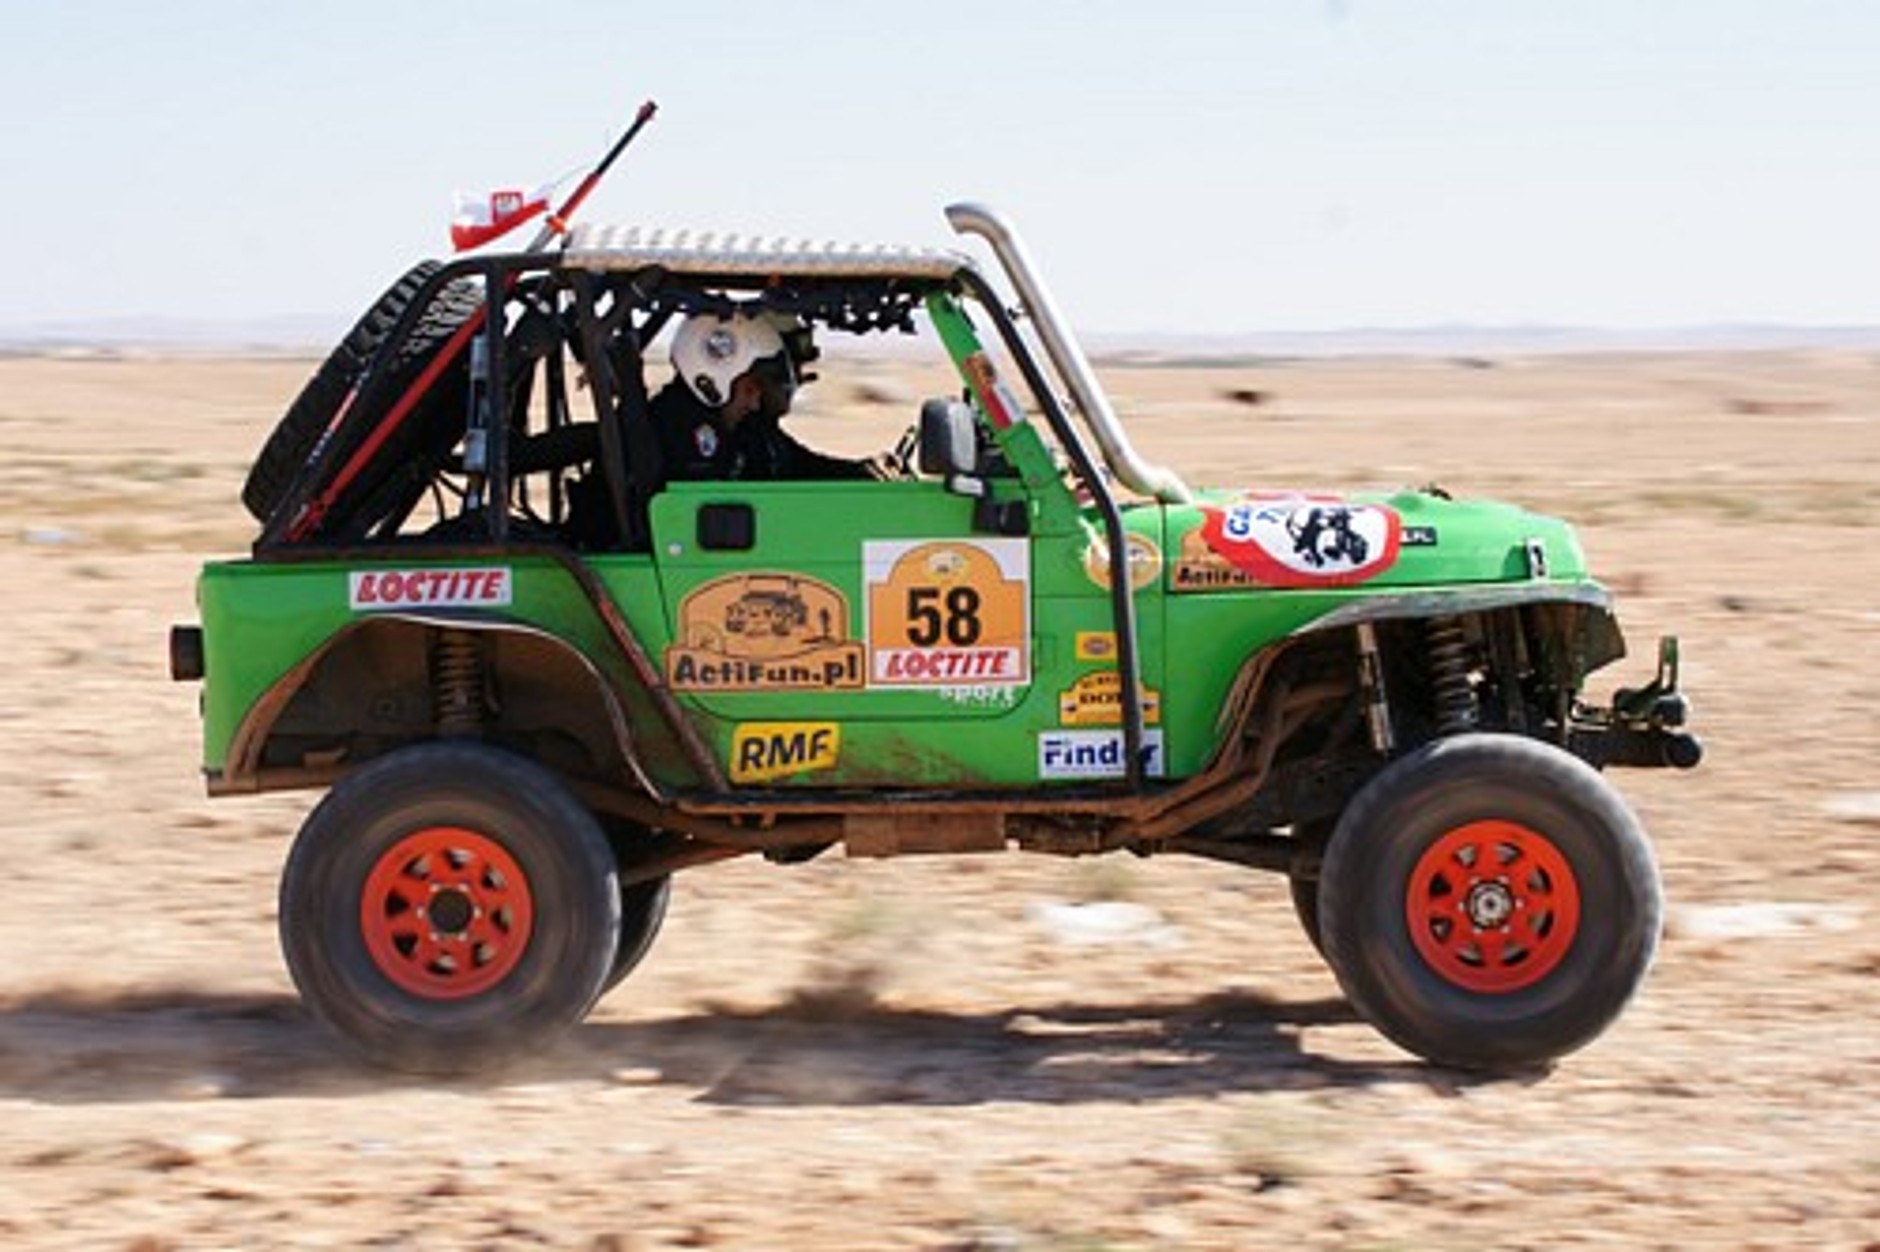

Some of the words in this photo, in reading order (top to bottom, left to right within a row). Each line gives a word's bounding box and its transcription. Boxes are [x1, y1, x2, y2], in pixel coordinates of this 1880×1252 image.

[357, 570, 505, 603] LOCTITE
[906, 586, 981, 647] 58
[886, 650, 1009, 677] LOCTITE
[740, 729, 832, 772] RMF
[1044, 739, 1159, 765] Findr
